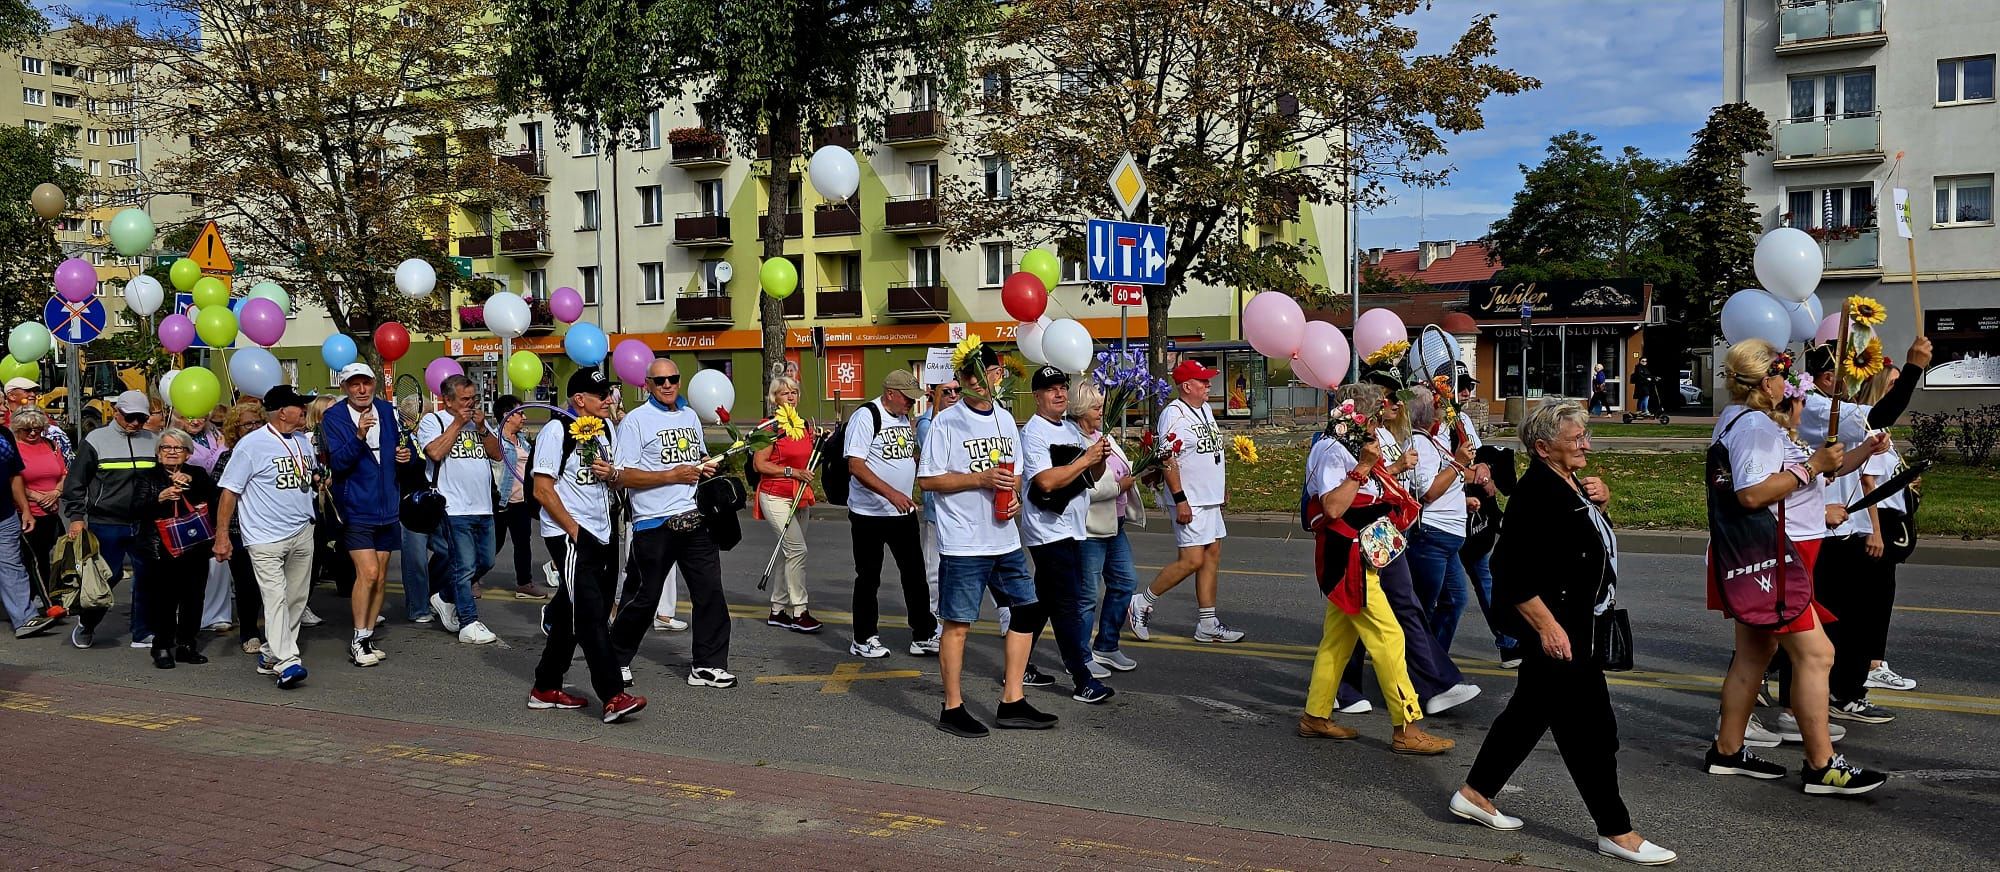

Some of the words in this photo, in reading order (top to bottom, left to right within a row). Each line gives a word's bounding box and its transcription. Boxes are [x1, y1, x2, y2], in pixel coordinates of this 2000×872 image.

[1117, 289, 1128, 301] 60
[1480, 282, 1548, 310] Jubiler
[1495, 328, 1560, 338] OBRCZKI
[667, 336, 697, 347] 7-20/7
[699, 334, 715, 346] dni
[473, 343, 493, 353] Apteka
[963, 436, 1013, 459] TENNIS
